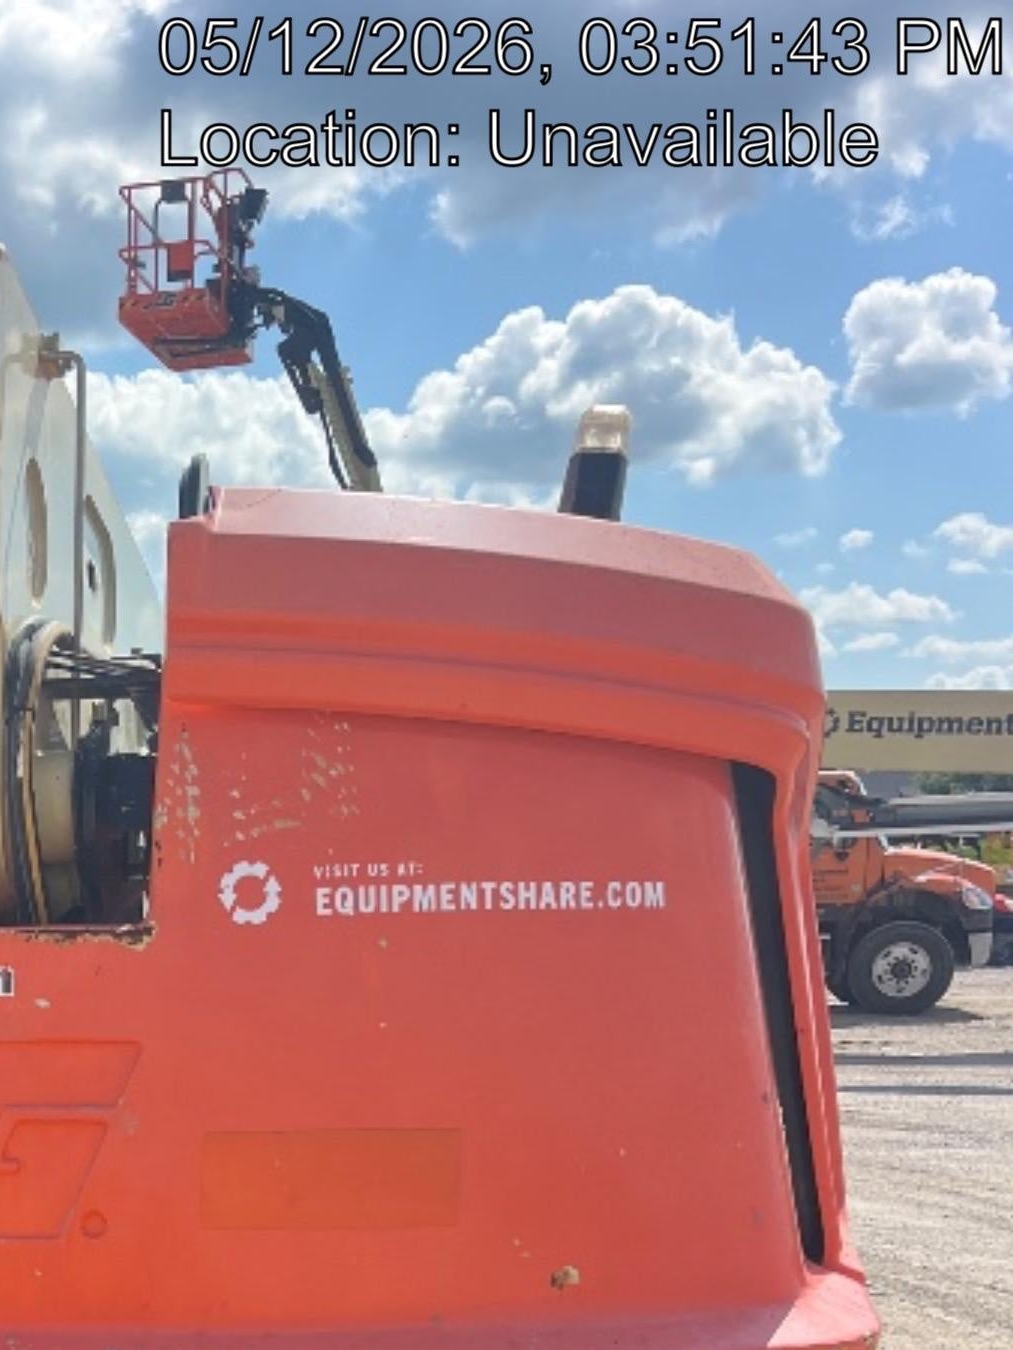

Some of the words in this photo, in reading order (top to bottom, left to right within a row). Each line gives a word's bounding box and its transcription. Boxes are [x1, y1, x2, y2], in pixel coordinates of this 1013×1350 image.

[313, 863, 361, 879] VISIT
[367, 863, 388, 877] US
[316, 881, 665, 916] EQUIPMENTSHARE.COM
